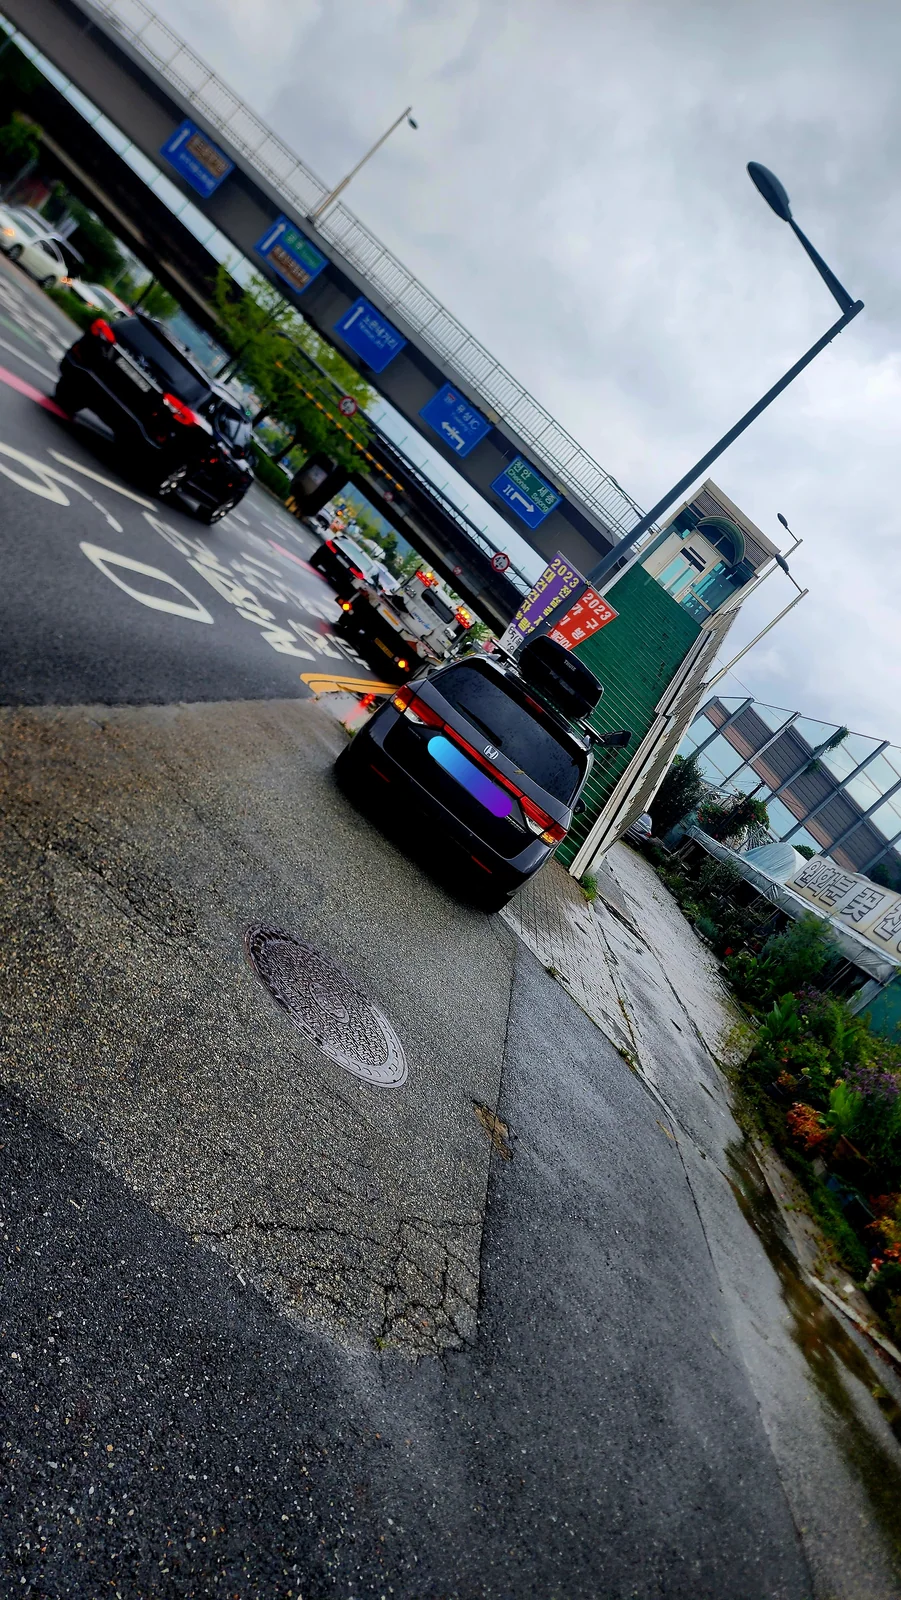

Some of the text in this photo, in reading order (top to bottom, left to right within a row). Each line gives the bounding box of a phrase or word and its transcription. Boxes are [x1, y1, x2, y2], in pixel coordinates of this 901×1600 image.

[507, 468, 549, 513] Cheonan Sejong
[513, 461, 557, 504] 천안 세종
[551, 558, 580, 588] 2023
[582, 592, 612, 621] 2023
[840, 887, 885, 922] 꽃
